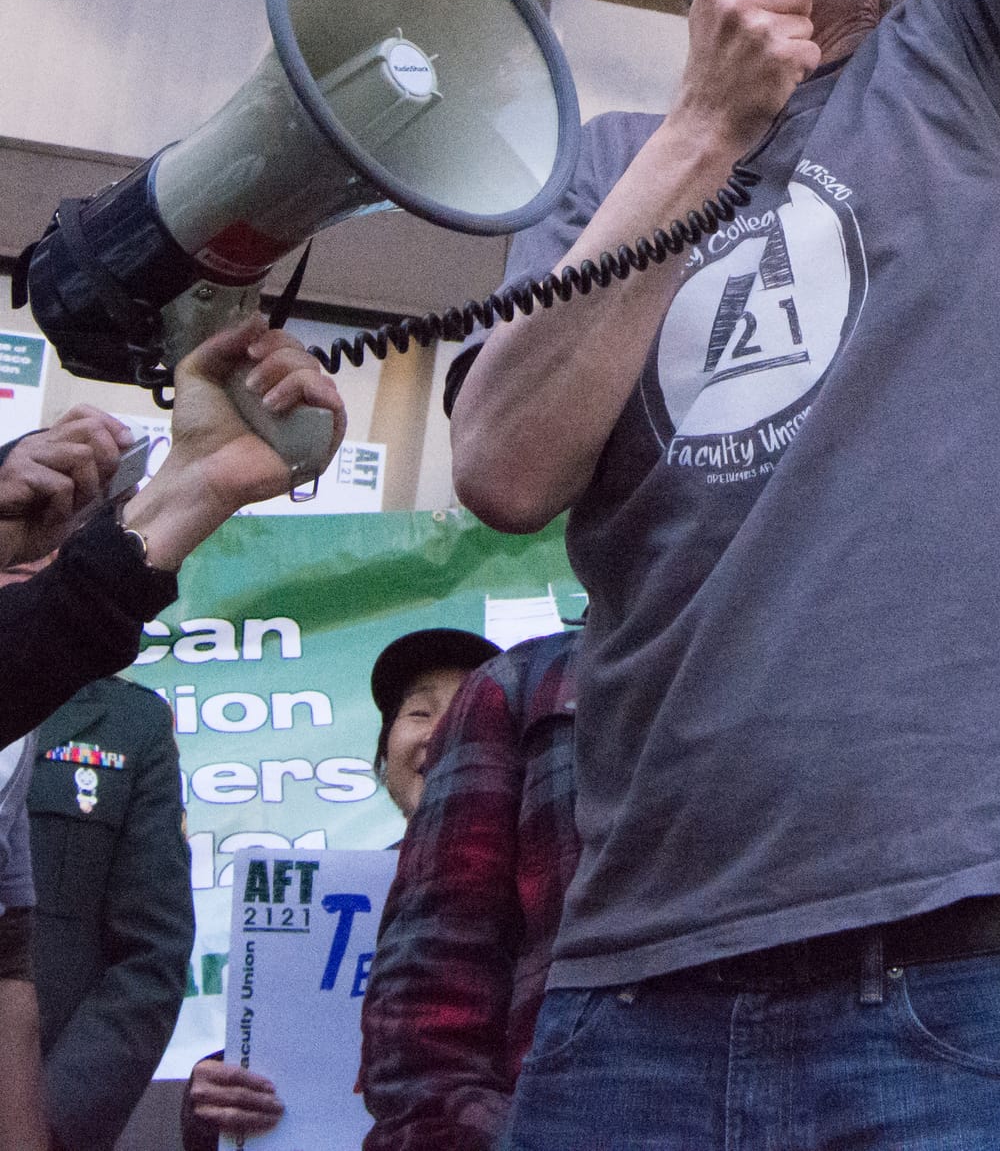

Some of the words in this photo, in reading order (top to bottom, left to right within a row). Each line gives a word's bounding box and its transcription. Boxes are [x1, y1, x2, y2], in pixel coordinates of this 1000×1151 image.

[353, 447, 380, 491] AFT
[667, 435, 755, 468] Faculty
[153, 684, 333, 734] ion
[181, 756, 378, 804] ers
[243, 859, 319, 904] AFT
[243, 907, 310, 927] 2121
[240, 940, 255, 999] Union
